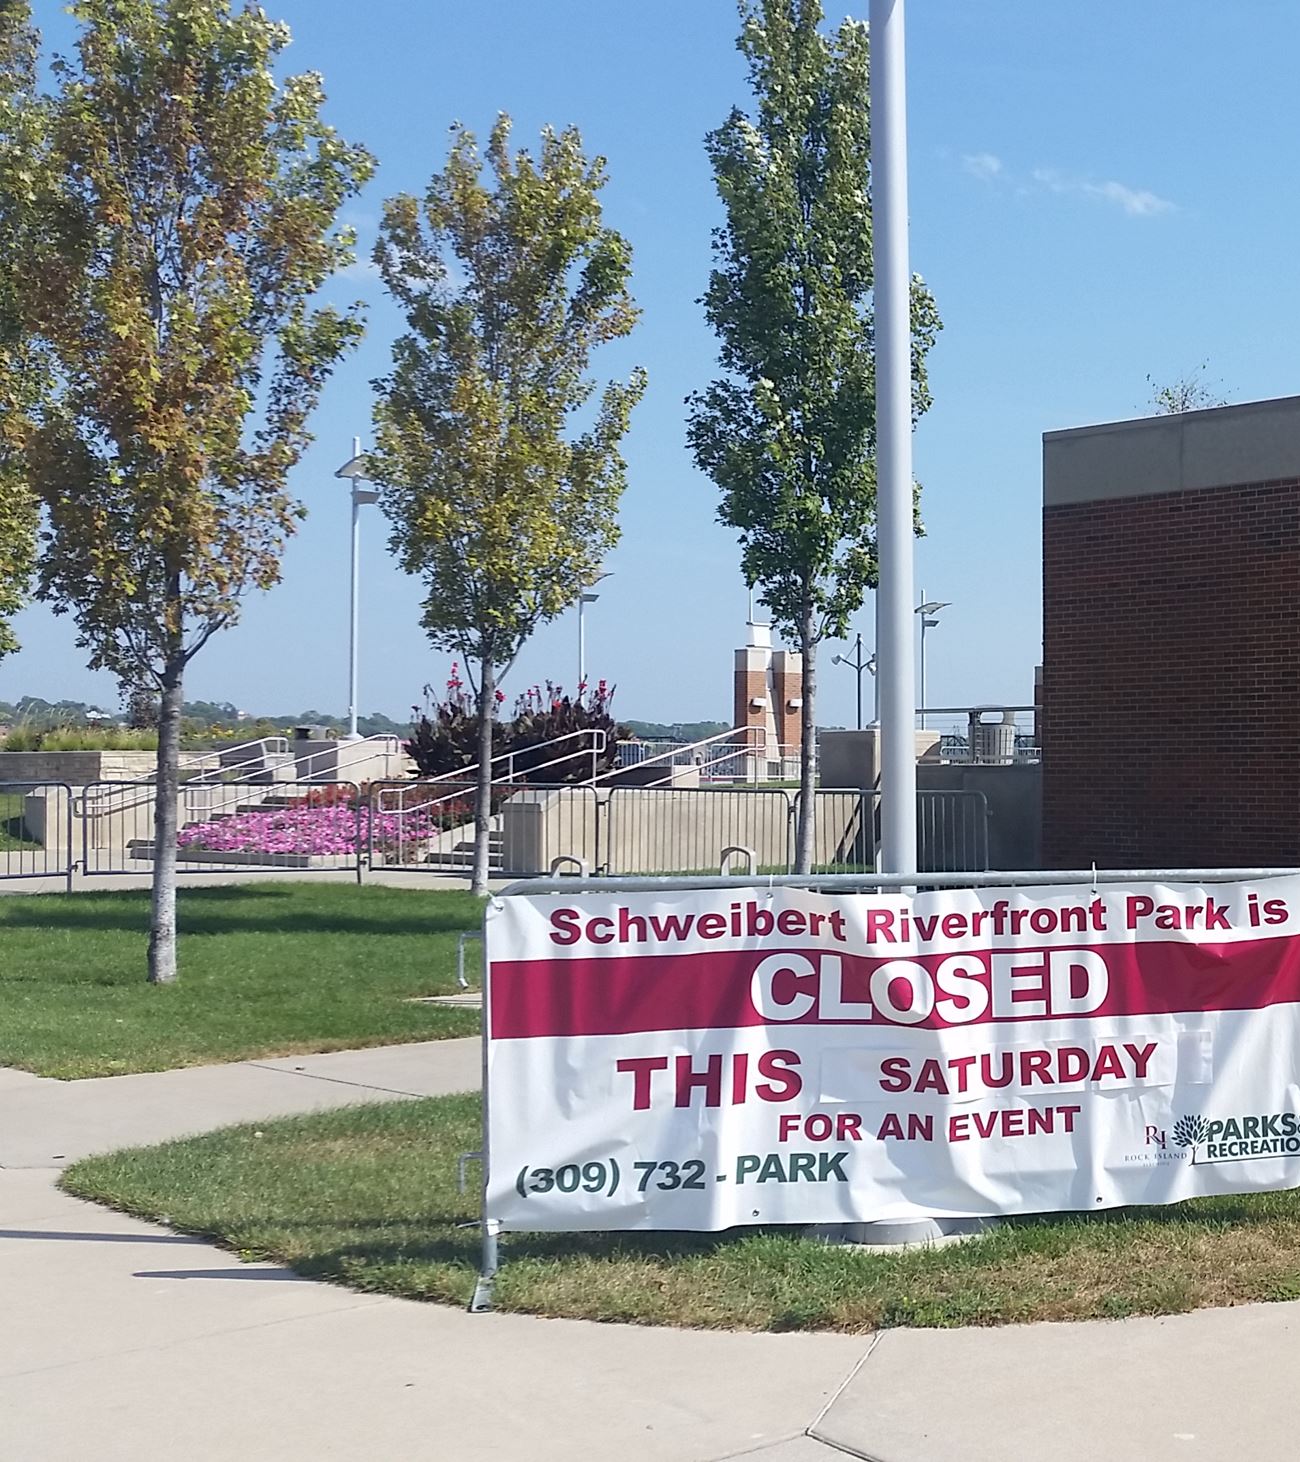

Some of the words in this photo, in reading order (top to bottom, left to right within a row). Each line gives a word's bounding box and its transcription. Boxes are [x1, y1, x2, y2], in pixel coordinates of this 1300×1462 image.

[549, 901, 845, 945] Schweibert
[865, 896, 1107, 945] Riverfront
[1125, 895, 1231, 931] Park
[1246, 893, 1290, 928] is
[750, 951, 1109, 1024] CLOSED
[615, 1049, 802, 1111] THIS
[879, 1042, 1158, 1094] SATURDAY
[778, 1113, 862, 1142] FOR
[876, 1114, 934, 1141] AN
[947, 1105, 1080, 1143] EVENT
[515, 1157, 621, 1199] (309)
[1154, 1152, 1188, 1160] ISLAND
